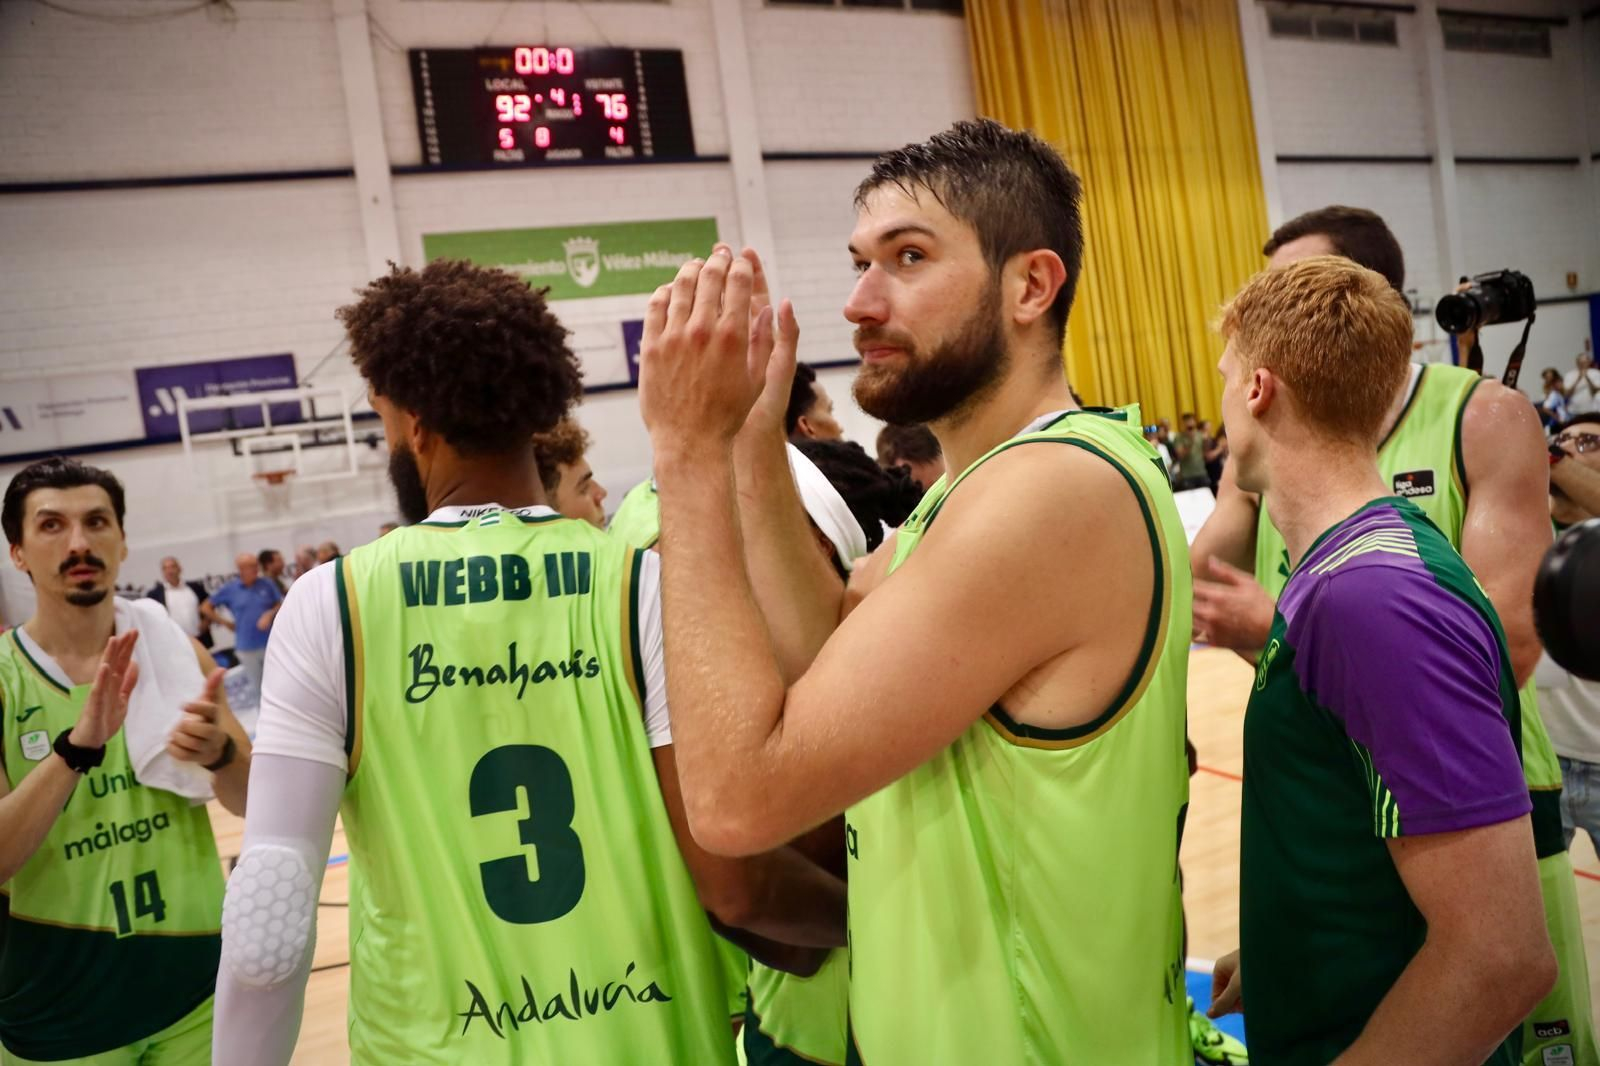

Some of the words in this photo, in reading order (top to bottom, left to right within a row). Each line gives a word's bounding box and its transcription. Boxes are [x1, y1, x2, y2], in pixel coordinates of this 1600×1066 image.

[485, 78, 527, 92] LOCAL
[550, 88, 565, 106] 4
[496, 94, 531, 122] 92
[595, 93, 628, 120] 76
[499, 127, 514, 149] 5
[609, 126, 624, 144] 4
[400, 554, 532, 607] WEBB
[544, 551, 591, 598] III
[64, 812, 170, 860] málaga
[469, 744, 586, 925] 3
[109, 869, 167, 937] 14
[456, 960, 673, 1039] Andalucía
[1537, 1026, 1563, 1037] acb
